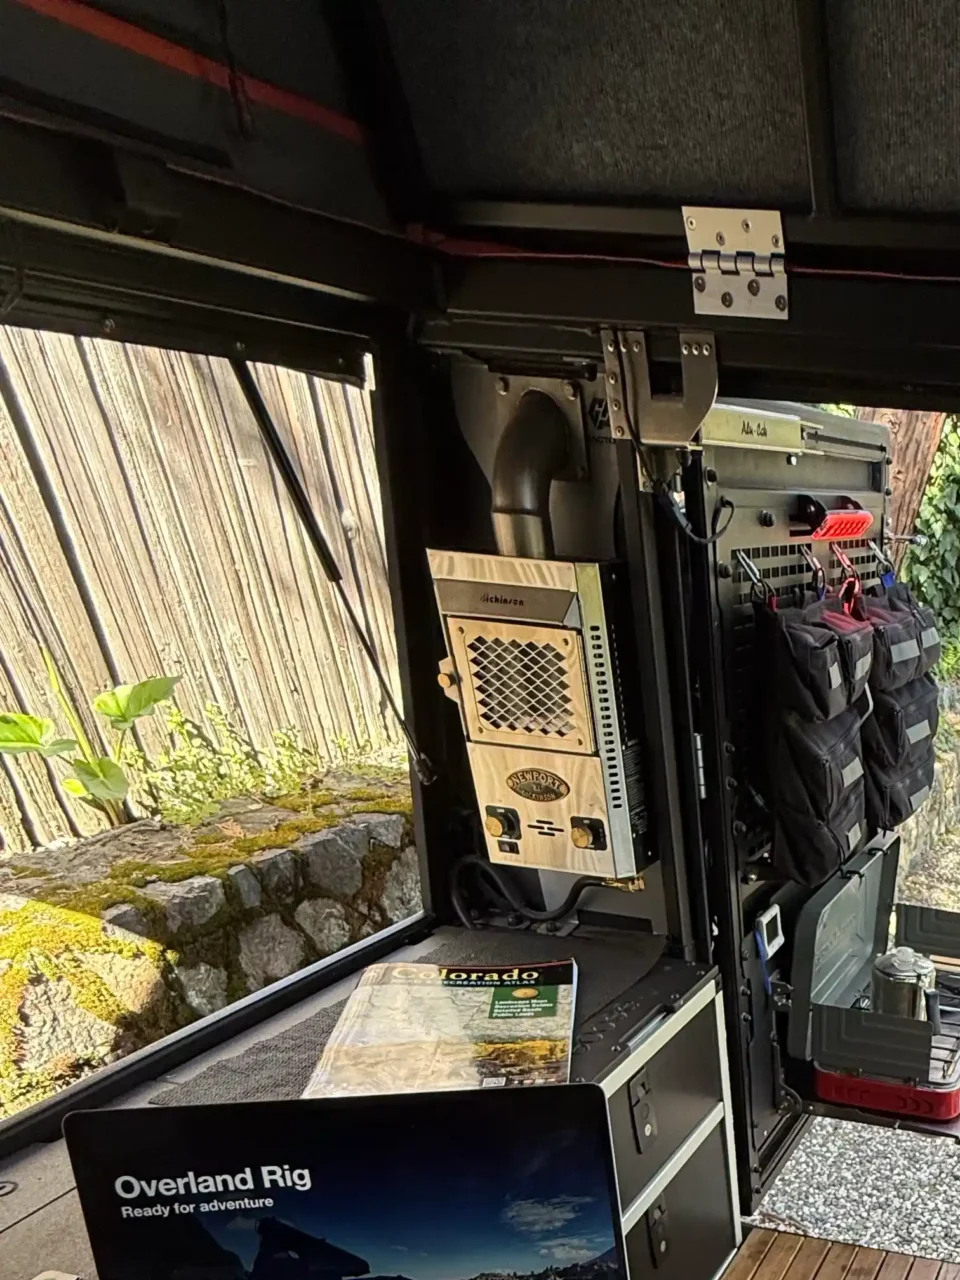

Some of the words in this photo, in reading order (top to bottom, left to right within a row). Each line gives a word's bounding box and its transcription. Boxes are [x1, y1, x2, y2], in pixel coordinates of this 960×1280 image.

[479, 592, 525, 607] dickinson
[511, 769, 562, 791] NEWPORT
[519, 789, 557, 801] DICKINSON
[391, 967, 540, 980] Colorado
[115, 1167, 254, 1199] Overland
[261, 1165, 312, 1192] Rig
[121, 1204, 170, 1219] Ready
[173, 1200, 196, 1215] for
[199, 1196, 275, 1213] adventure
